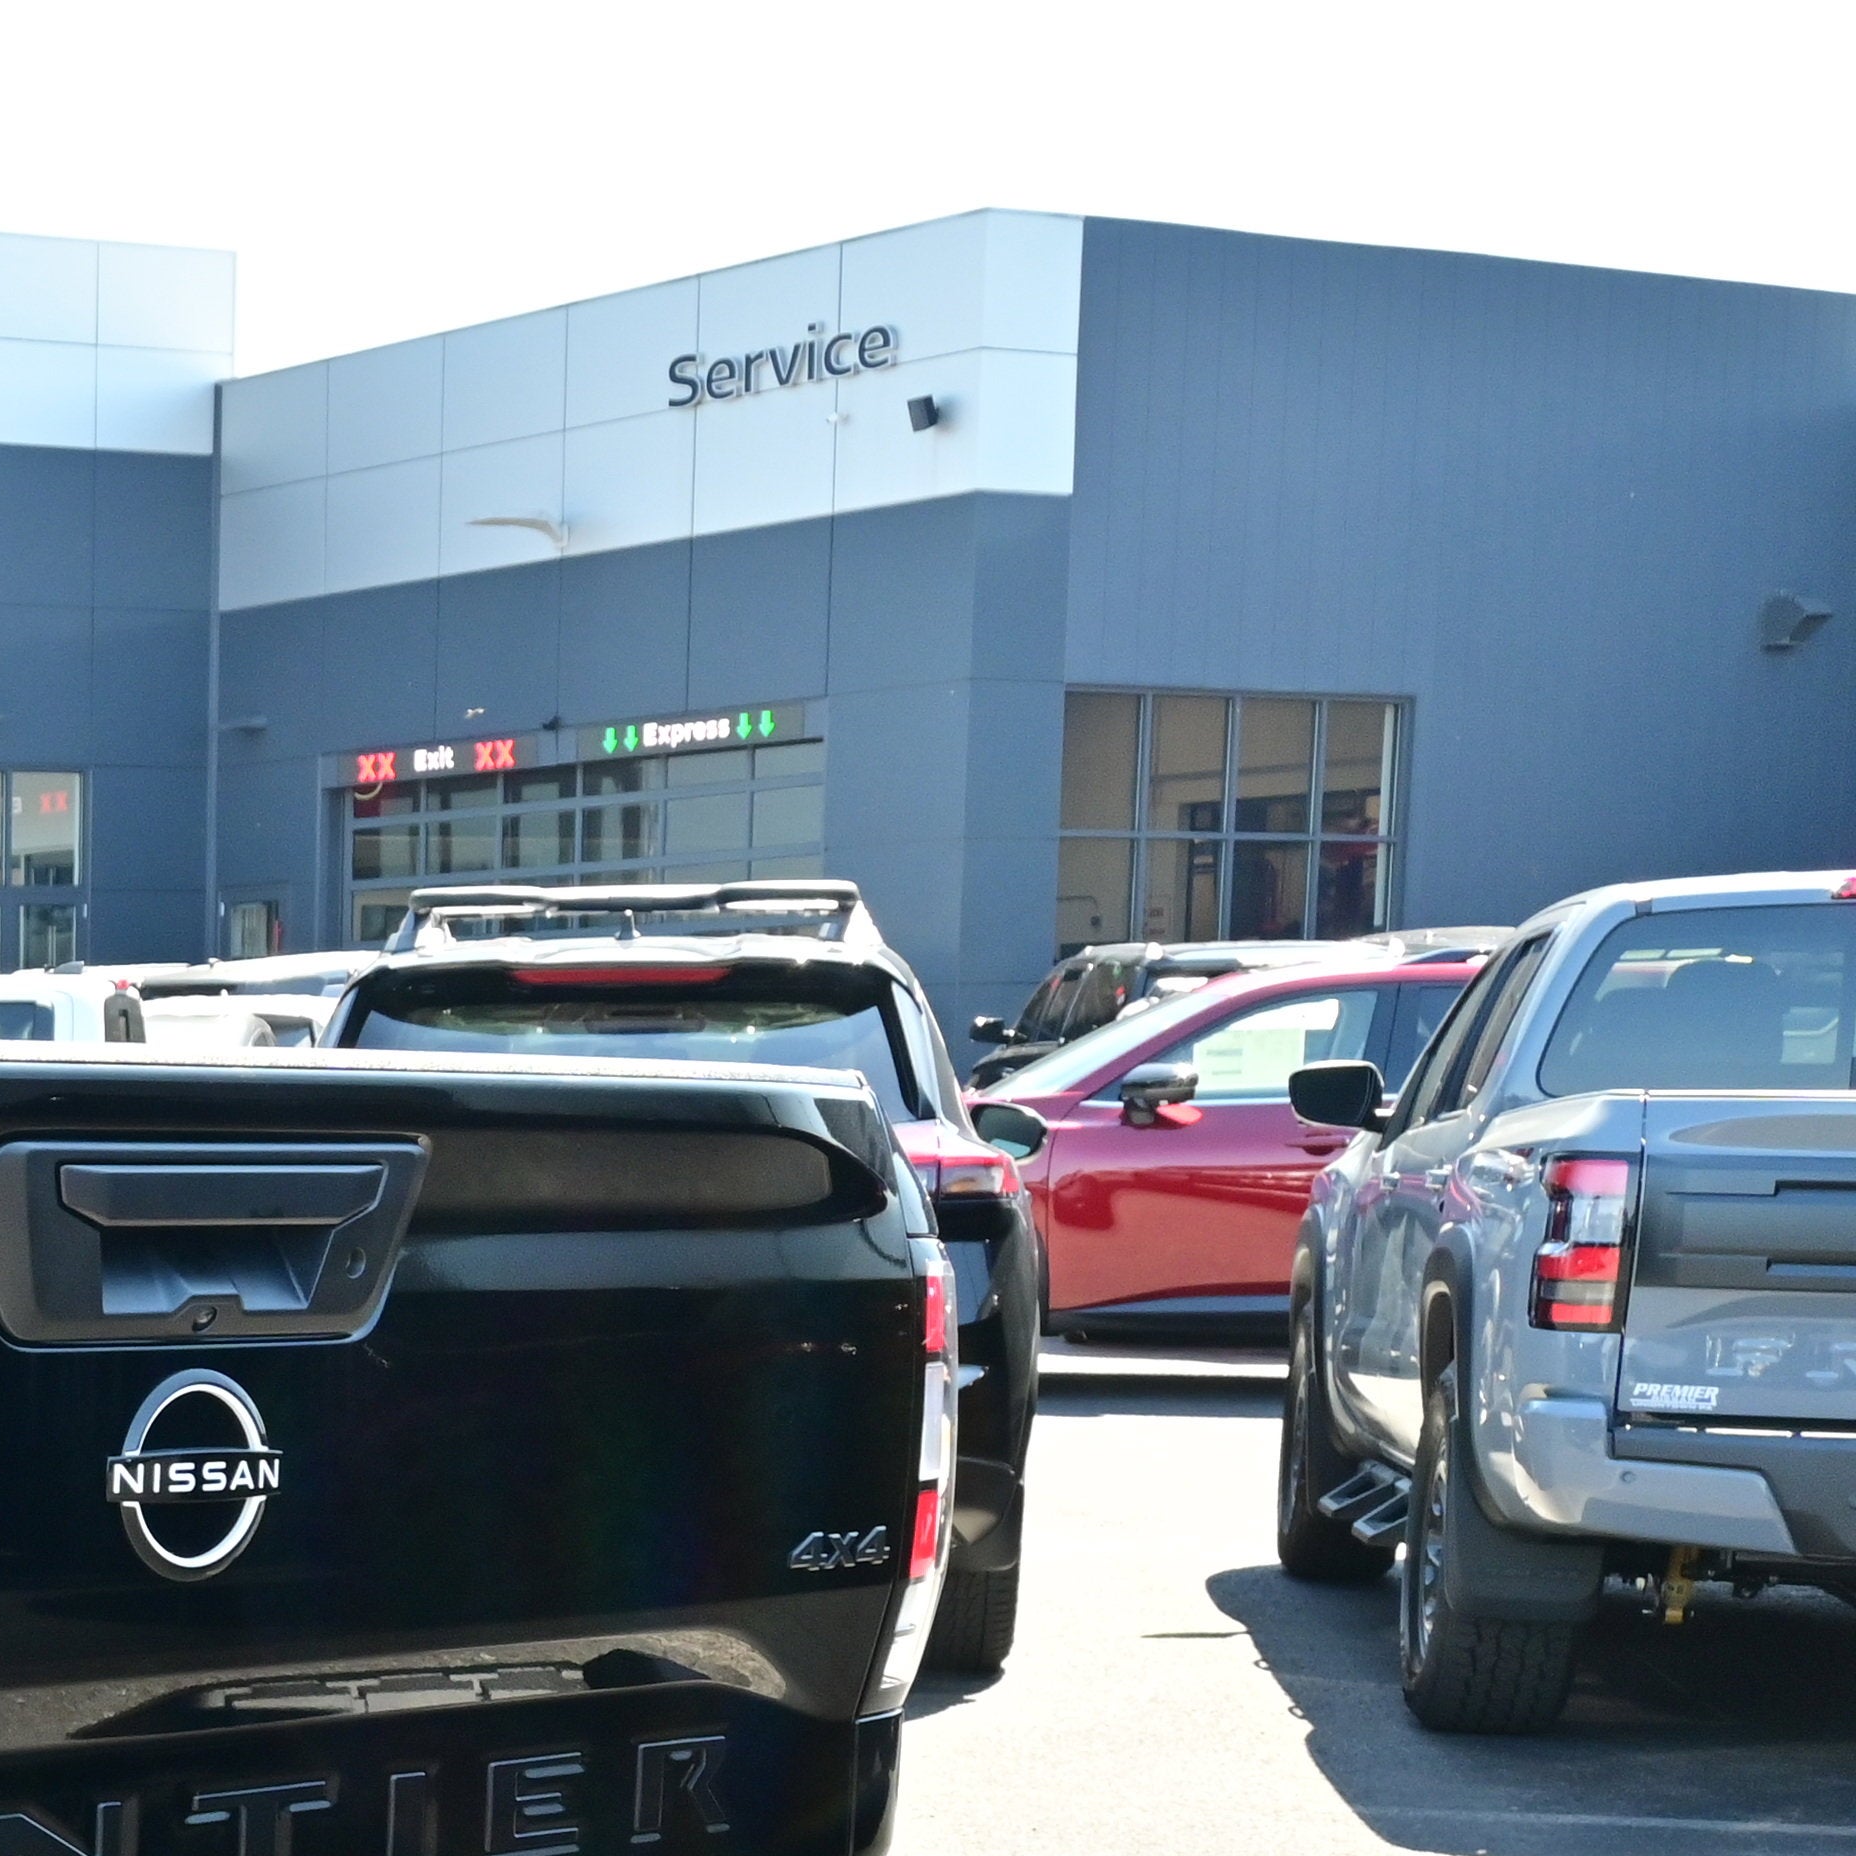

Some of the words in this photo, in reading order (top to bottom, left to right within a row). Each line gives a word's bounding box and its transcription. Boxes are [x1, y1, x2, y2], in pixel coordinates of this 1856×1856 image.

[668, 321, 898, 408] Service
[642, 716, 731, 749] Express
[413, 745, 455, 773] Exit
[1632, 1382, 1720, 1407] PREMIER
[111, 1458, 281, 1495] NISSAN
